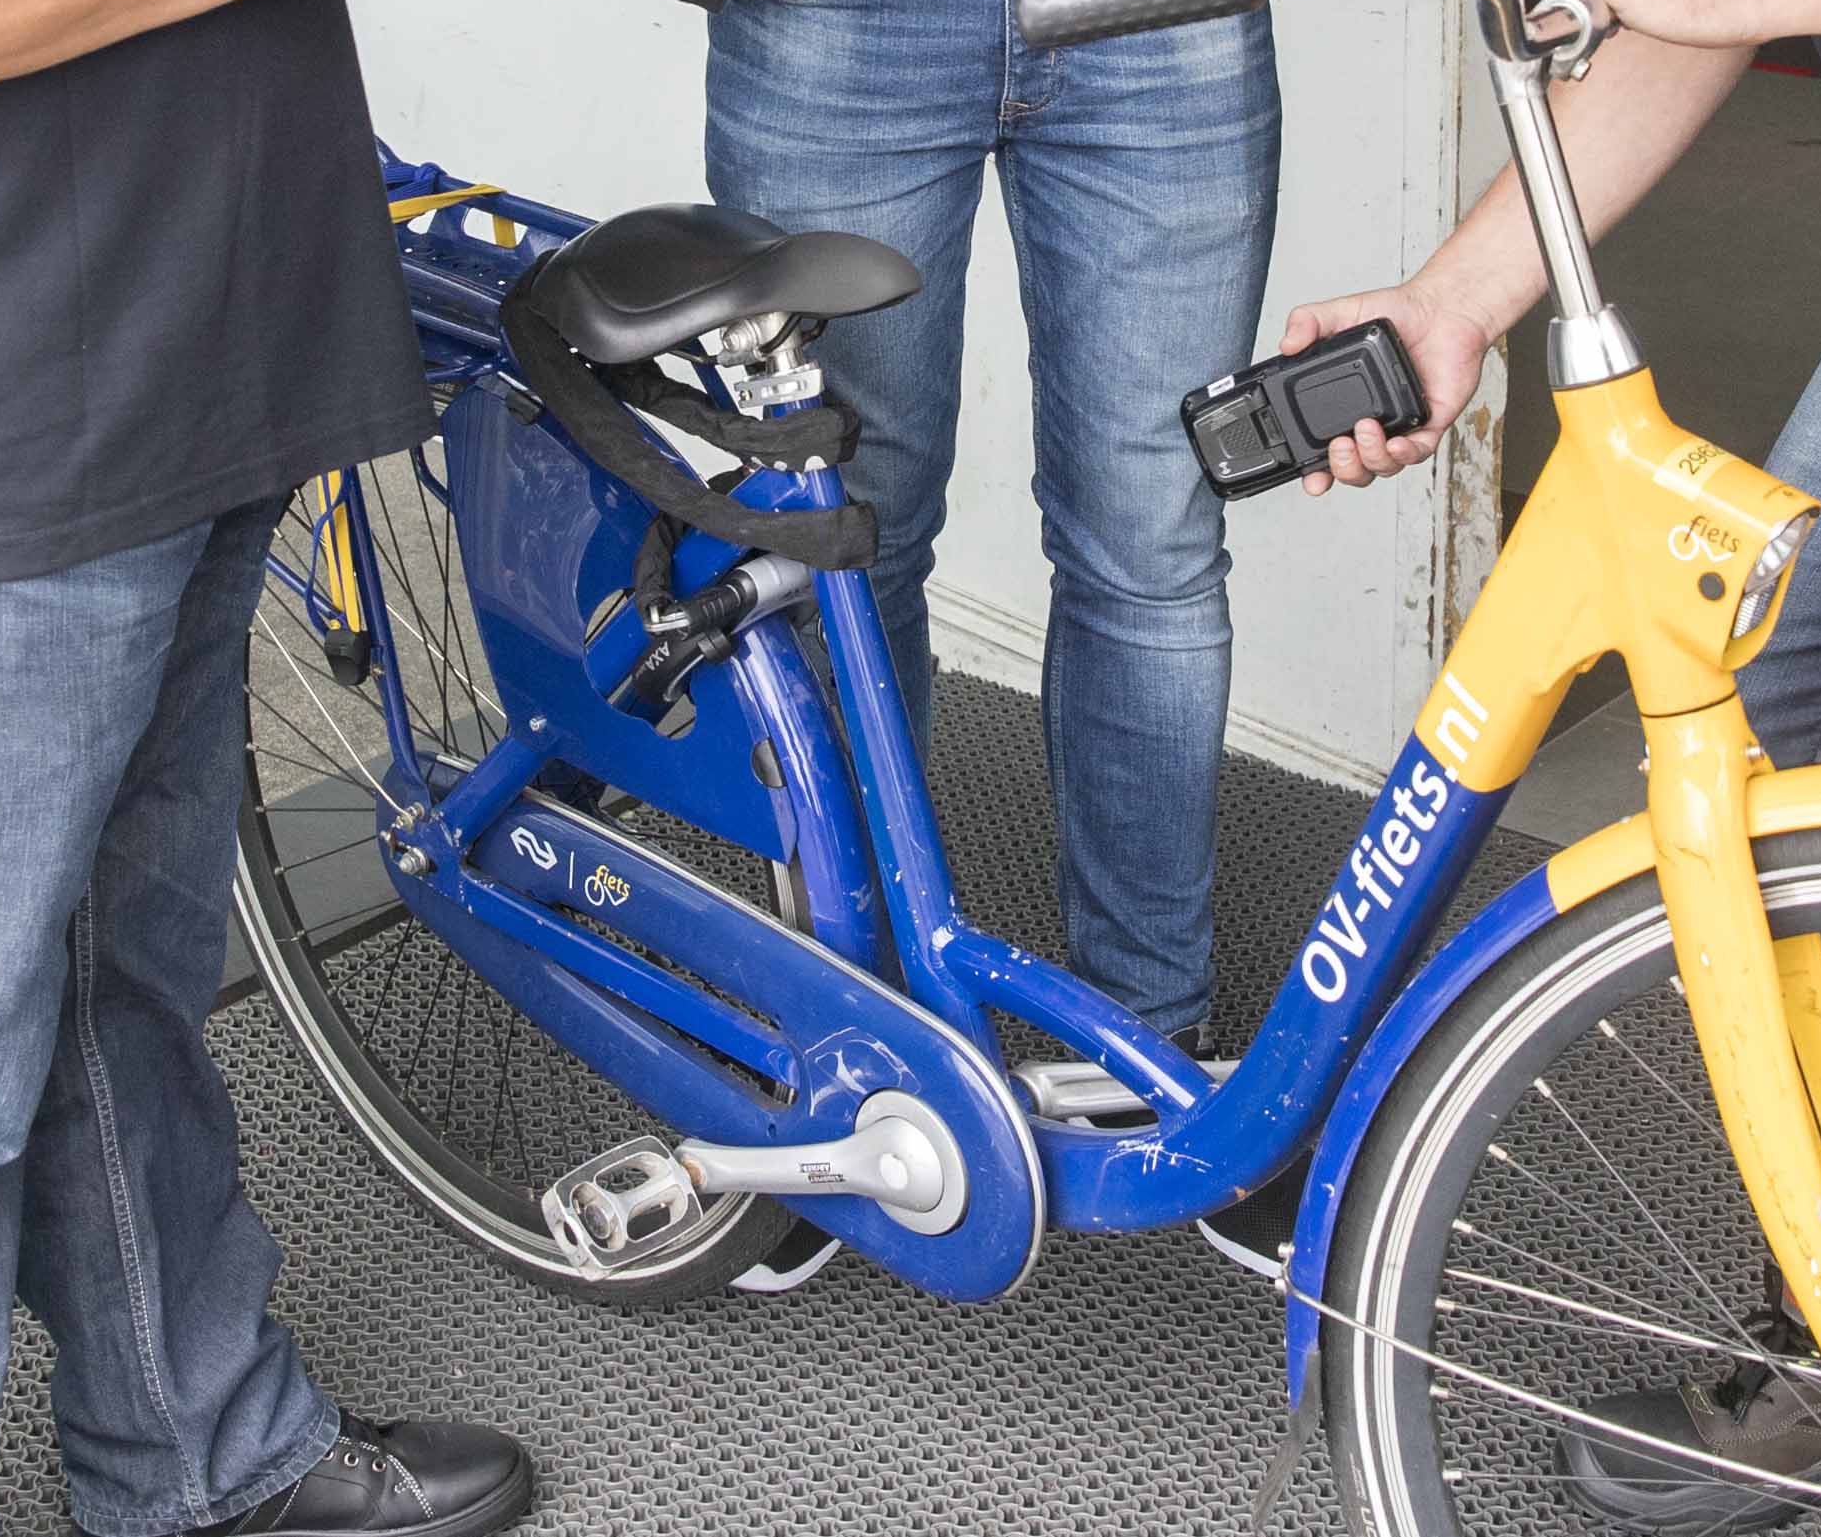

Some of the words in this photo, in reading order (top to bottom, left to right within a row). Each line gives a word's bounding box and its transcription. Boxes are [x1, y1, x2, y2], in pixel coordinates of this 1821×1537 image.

[1684, 514, 1742, 553] fiets
[1301, 672, 1490, 1004] OV-fiets.nl
[594, 864, 631, 898] fiets
